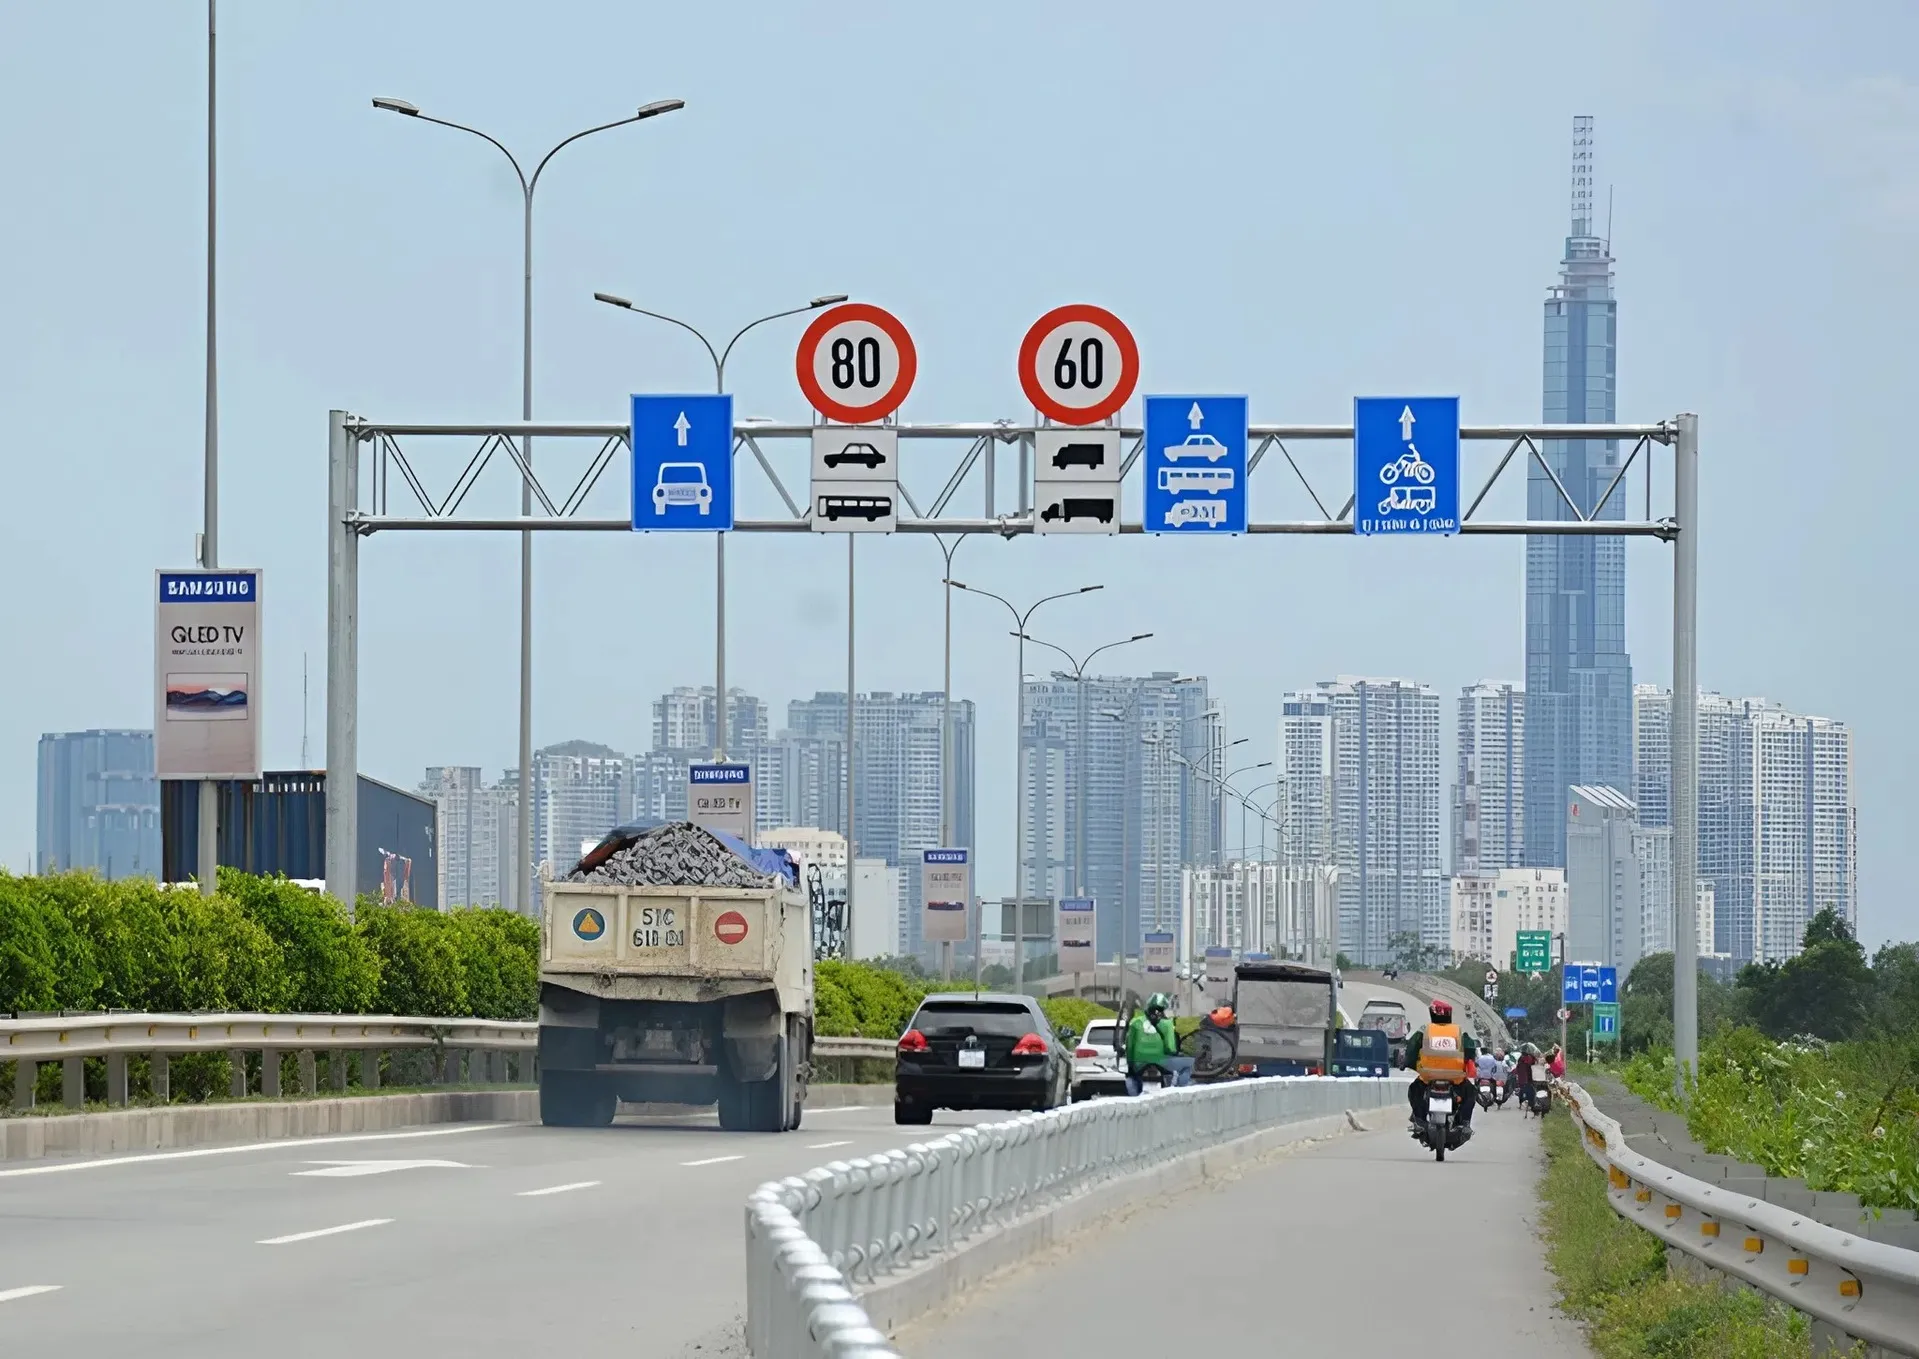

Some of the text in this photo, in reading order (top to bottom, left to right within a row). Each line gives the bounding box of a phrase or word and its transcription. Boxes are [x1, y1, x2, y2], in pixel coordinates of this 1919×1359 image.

[831, 336, 881, 389] 80
[1054, 337, 1104, 390] 60
[222, 625, 244, 643] TV
